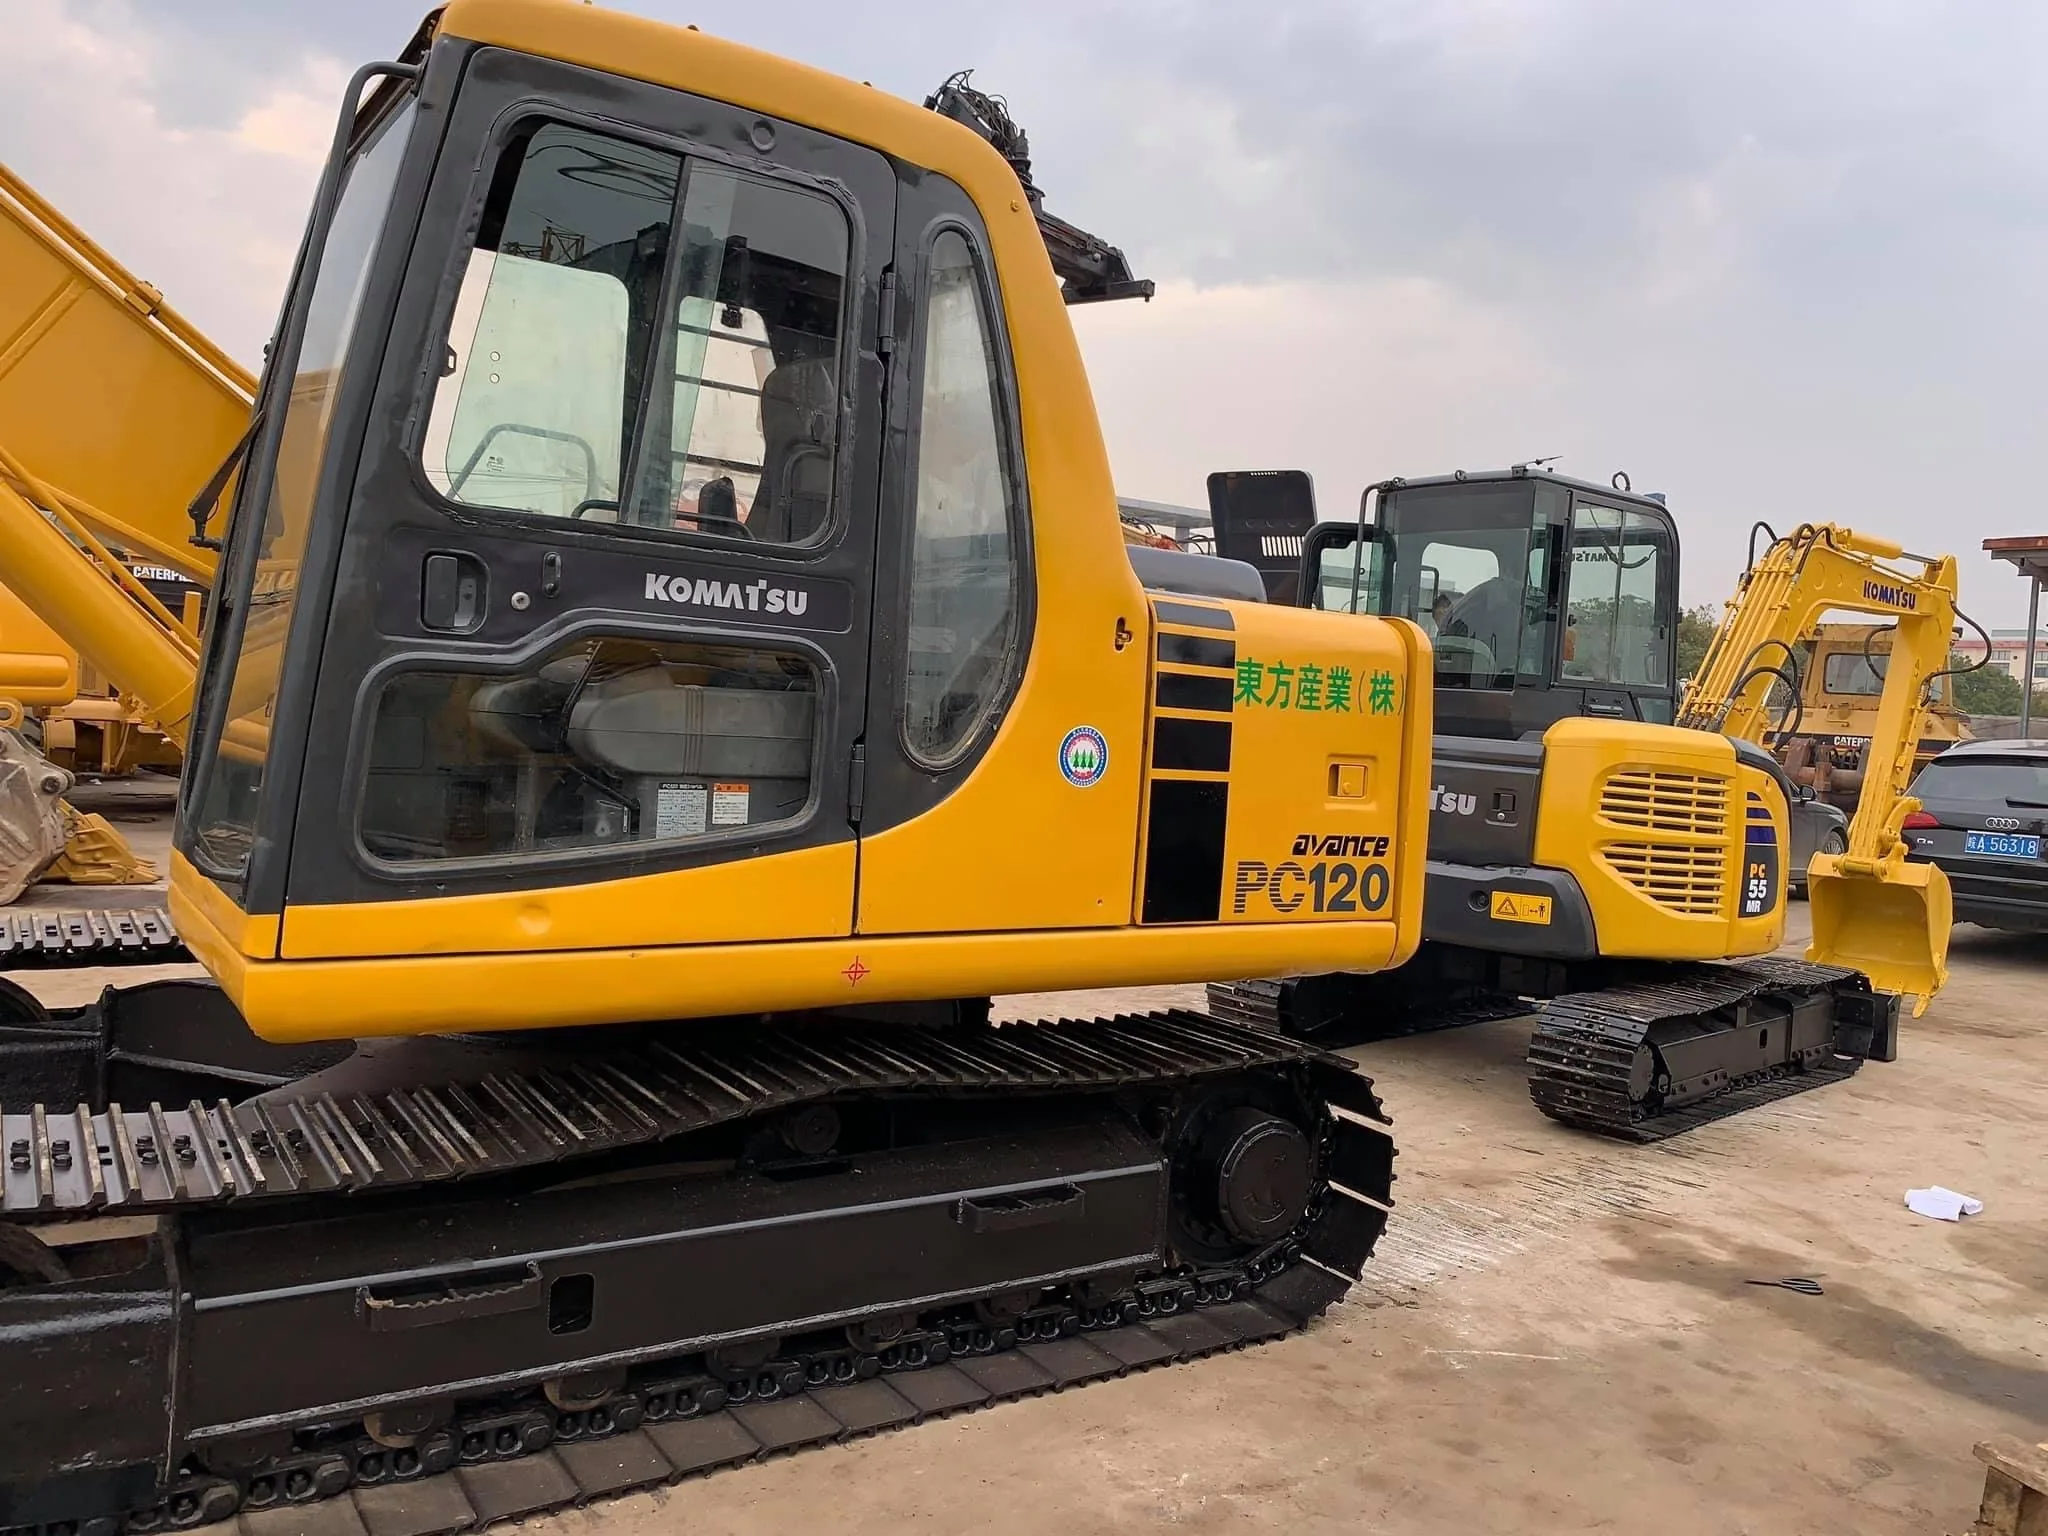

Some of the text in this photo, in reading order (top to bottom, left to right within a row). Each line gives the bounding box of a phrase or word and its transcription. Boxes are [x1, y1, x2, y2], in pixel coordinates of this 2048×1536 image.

[645, 572, 808, 616] KOMATSU
[1863, 580, 1916, 610] KOMATSU
[1292, 834, 1390, 857] avance
[1750, 863, 1766, 878] PC
[1233, 861, 1390, 914] PC120
[1748, 879, 1768, 899] 55
[1746, 900, 1761, 913] MR
